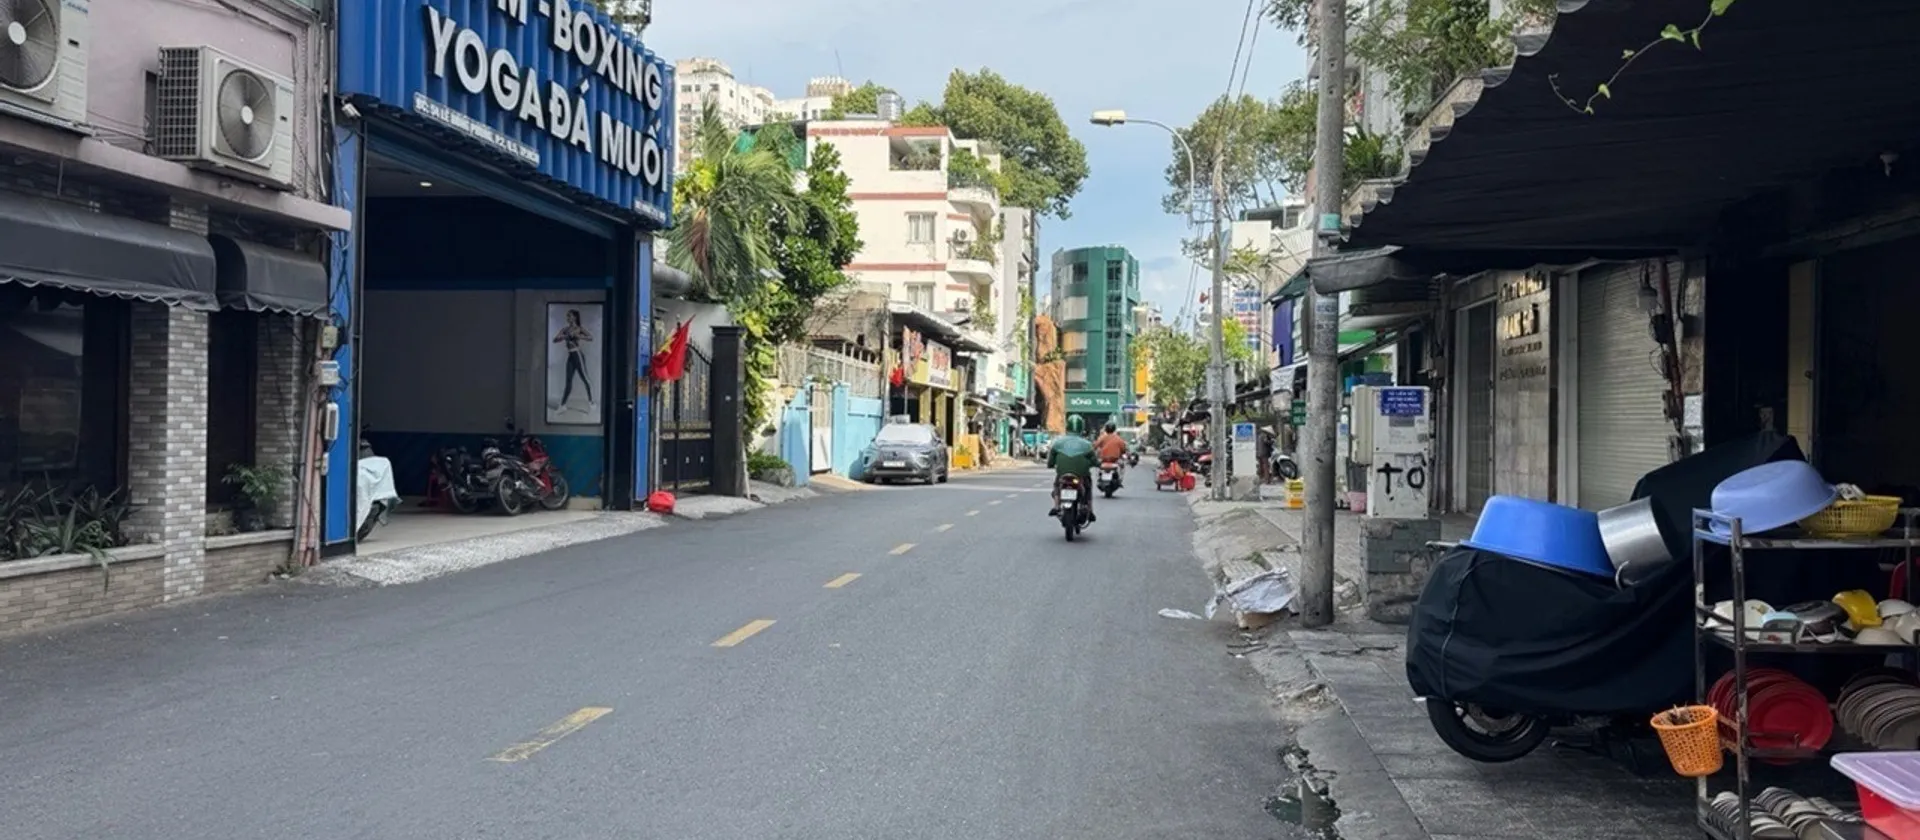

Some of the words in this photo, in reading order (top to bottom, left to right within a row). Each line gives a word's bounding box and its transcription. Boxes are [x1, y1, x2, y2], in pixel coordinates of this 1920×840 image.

[426, 6, 545, 130] YOGA
[549, 79, 592, 153] ĐÁ
[600, 111, 668, 193] MUỐI
